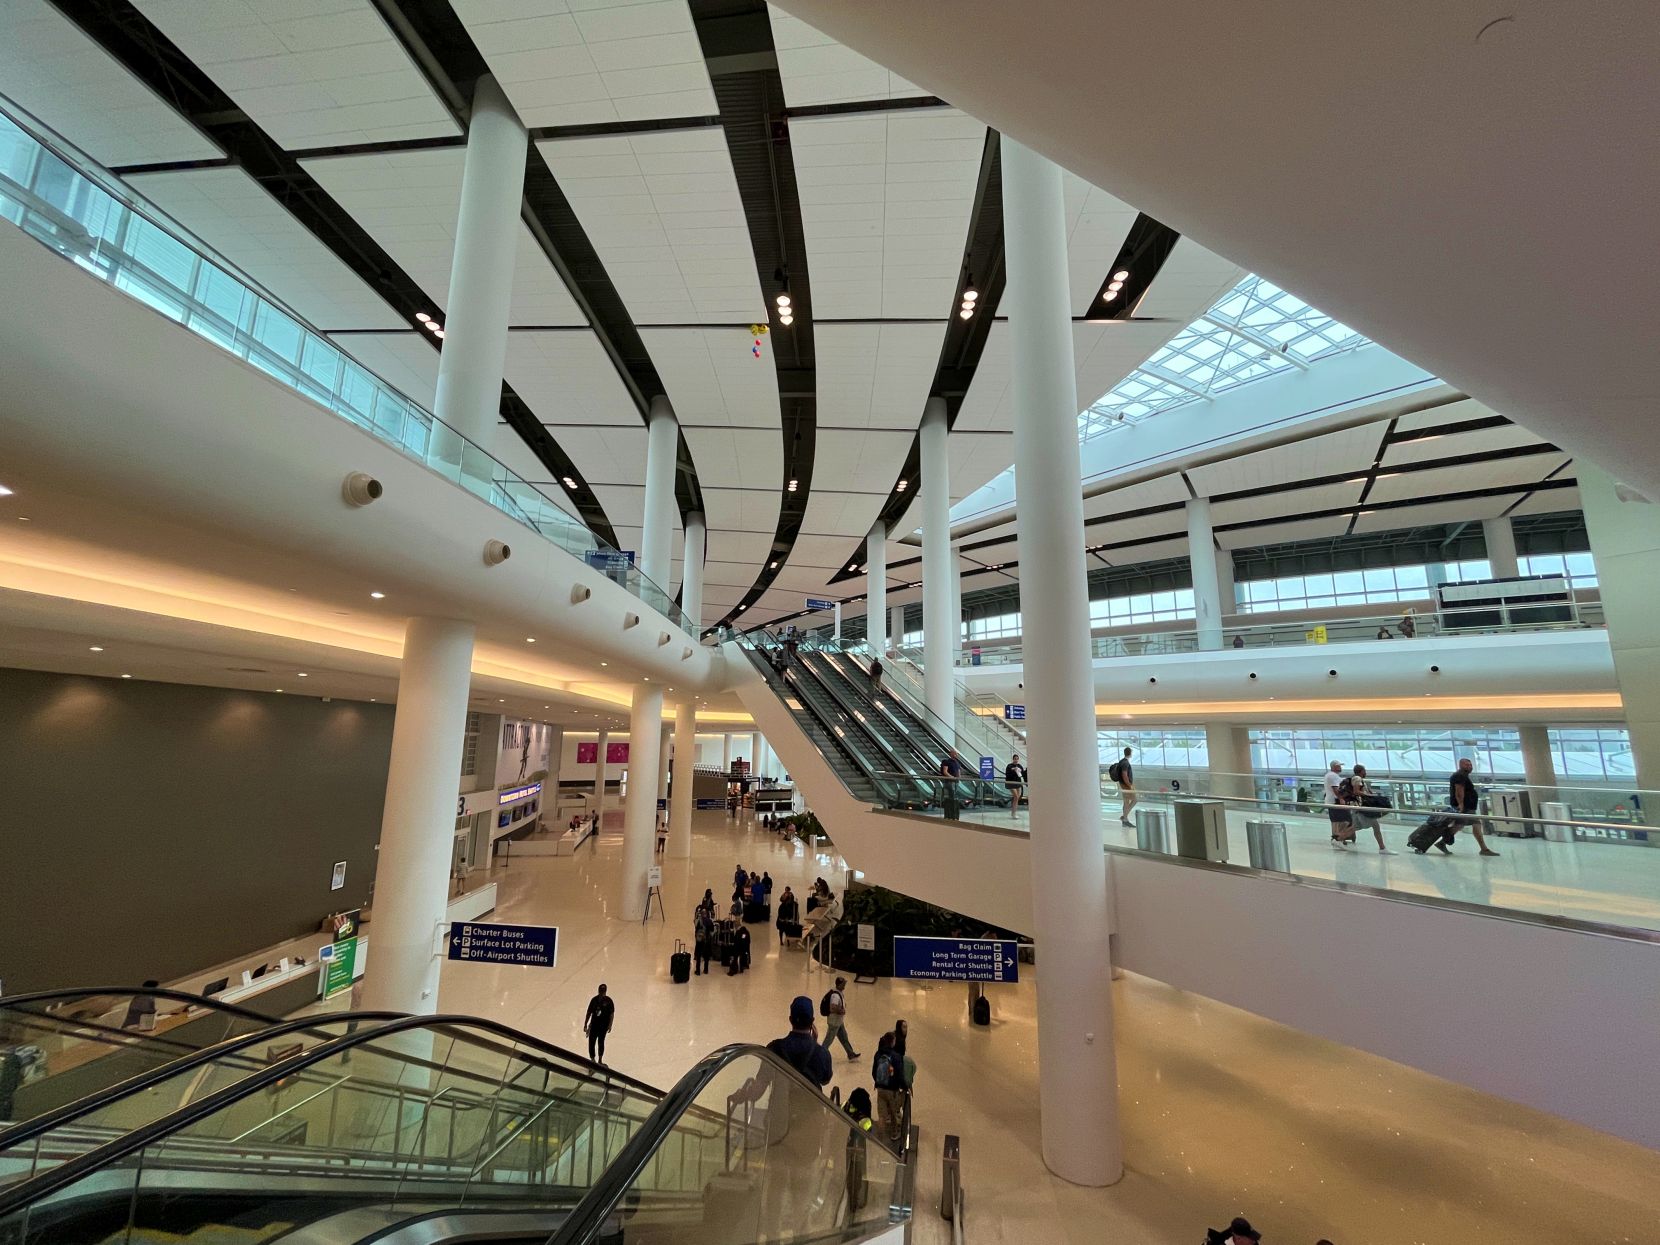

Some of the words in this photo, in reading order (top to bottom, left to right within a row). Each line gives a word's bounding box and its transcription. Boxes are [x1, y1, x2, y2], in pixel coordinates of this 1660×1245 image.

[1171, 780, 1180, 791] 9
[457, 796, 466, 816] 3
[472, 927, 501, 937] Charter
[502, 929, 525, 939] Buses
[471, 938, 500, 948] Surface
[501, 940, 514, 949] Lot
[515, 941, 544, 953] Parking
[959, 943, 972, 951] Bag
[973, 943, 992, 951] Claim
[470, 949, 515, 961] Off-Airport
[516, 953, 548, 963] Shuttles
[932, 952, 949, 960] Long
[968, 953, 992, 961] Garage
[932, 961, 954, 969] Rental
[968, 962, 993, 970] Shuttle
[910, 969, 940, 978] Economy
[941, 970, 967, 980] Parking
[968, 971, 993, 979] Shuttle
